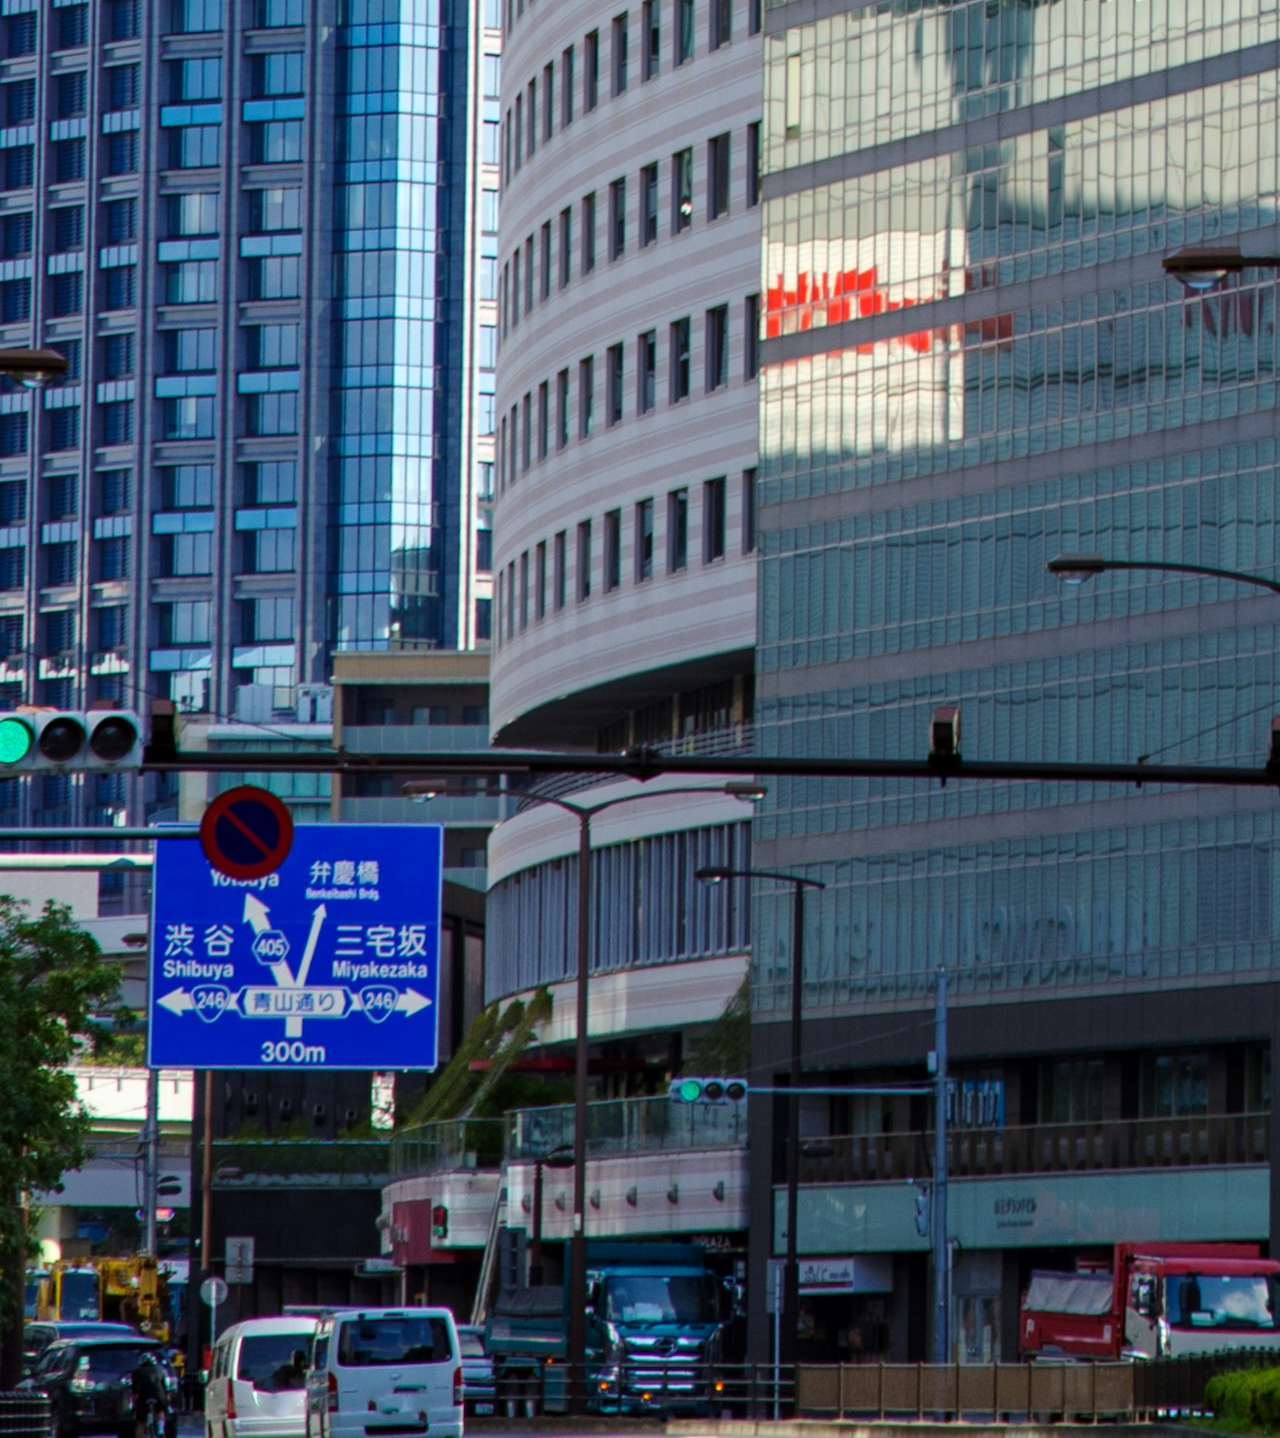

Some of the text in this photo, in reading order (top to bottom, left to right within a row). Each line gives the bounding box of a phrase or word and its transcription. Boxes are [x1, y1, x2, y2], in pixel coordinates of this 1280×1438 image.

[310, 859, 379, 885] 弁慶橋
[165, 923, 234, 956] 渋谷
[257, 940, 285, 955] 405
[334, 924, 427, 957] 三宅坂
[163, 959, 234, 981] Shibuya
[332, 960, 427, 981] Miyakezaka
[197, 991, 224, 1008] 246
[253, 993, 336, 1012] 青山通り
[365, 991, 392, 1008] 246
[261, 1041, 326, 1063] 300m
